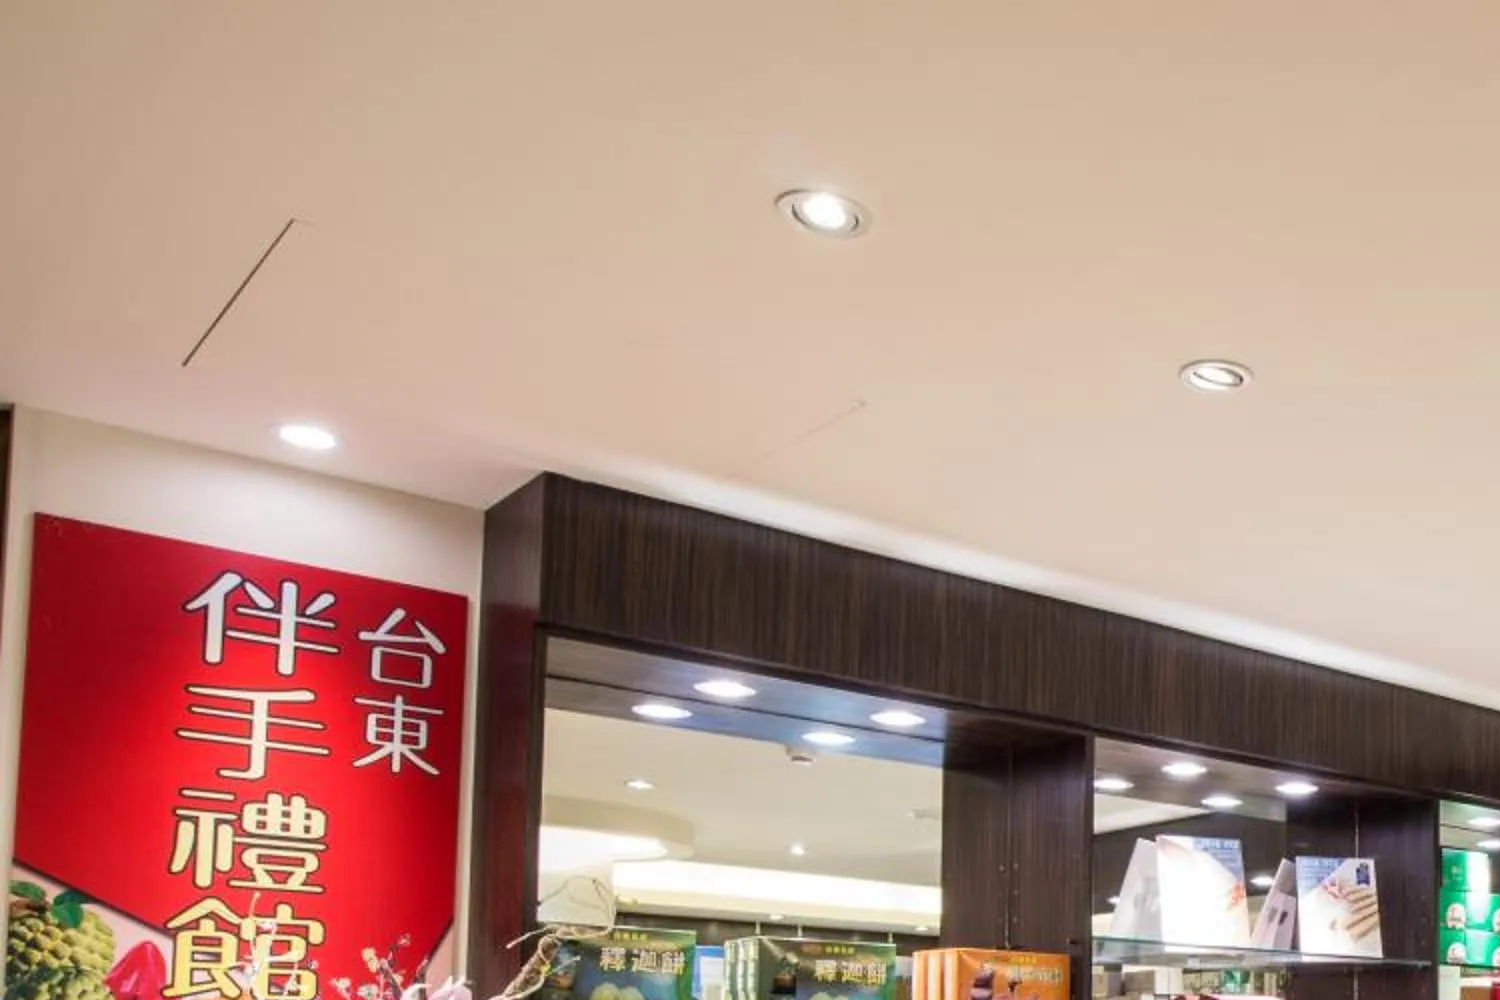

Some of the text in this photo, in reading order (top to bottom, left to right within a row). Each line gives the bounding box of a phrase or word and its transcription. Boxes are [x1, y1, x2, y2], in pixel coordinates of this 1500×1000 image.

[161, 571, 340, 1000] 伴手禮館
[352, 607, 447, 776] 台東
